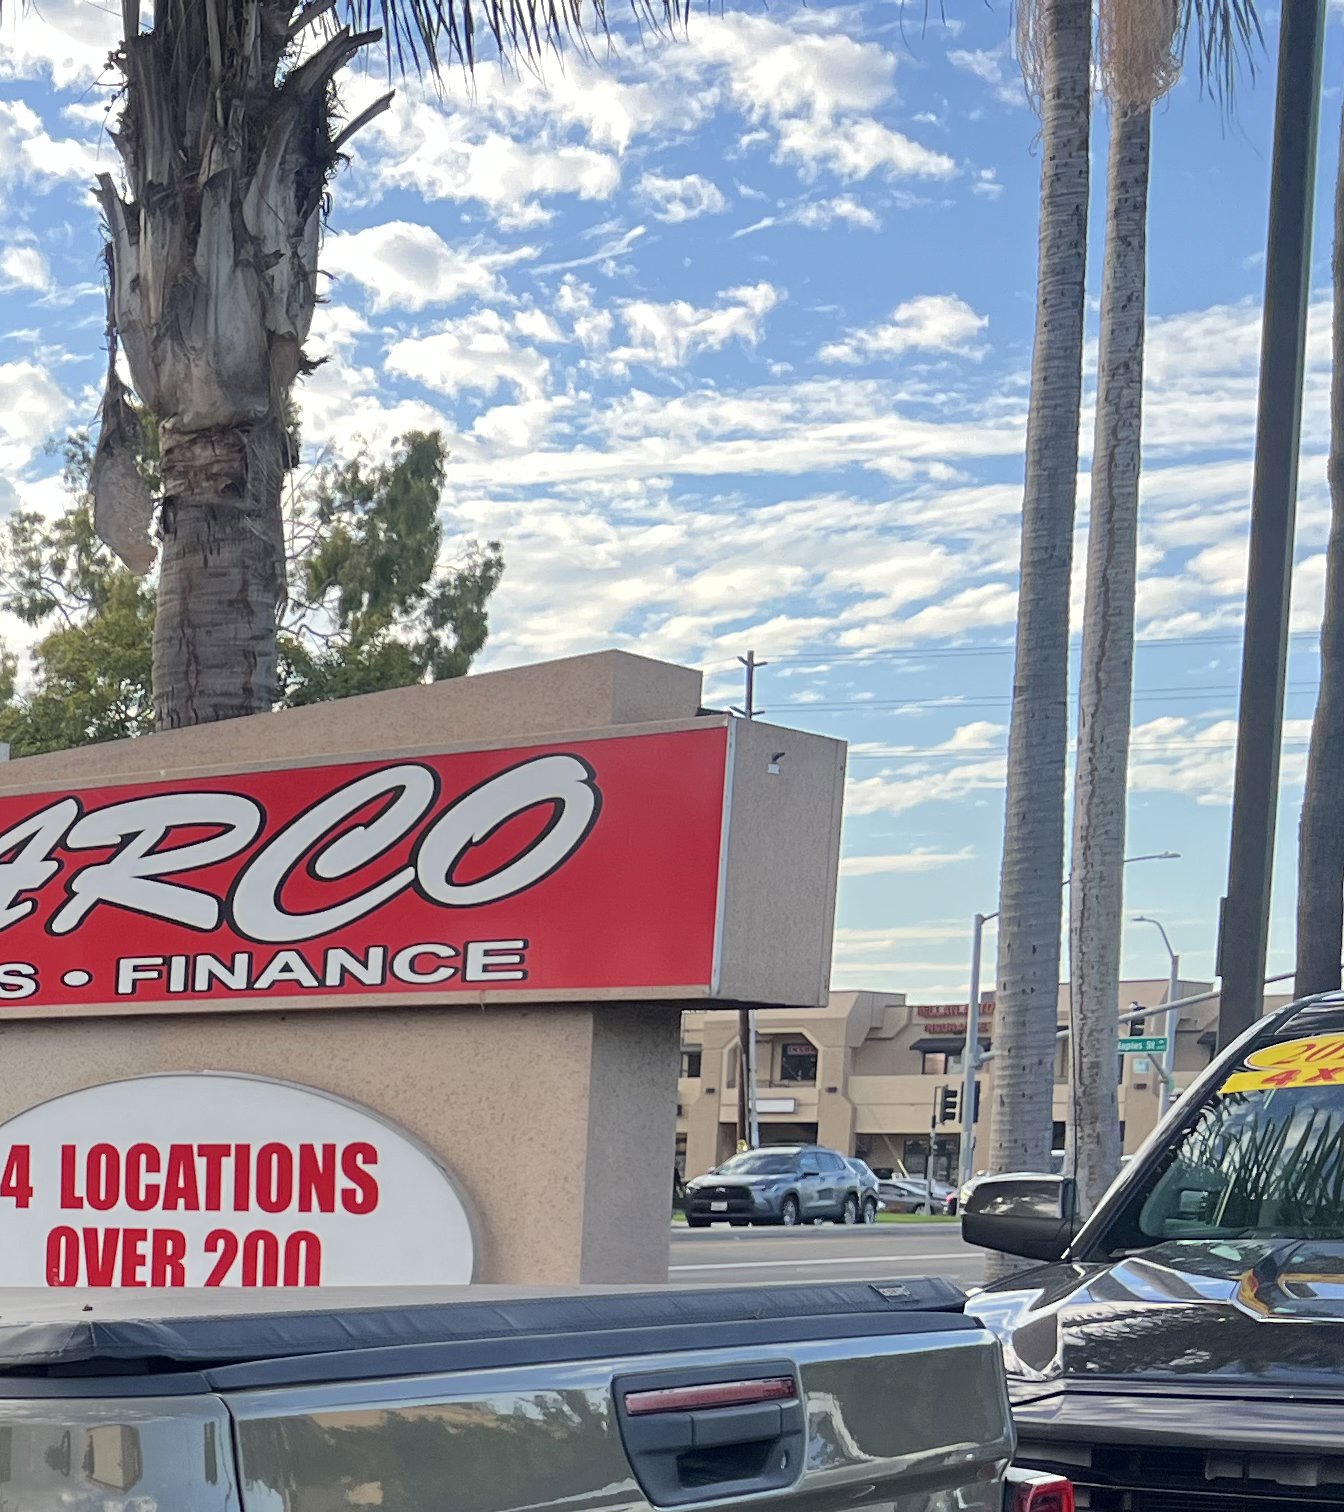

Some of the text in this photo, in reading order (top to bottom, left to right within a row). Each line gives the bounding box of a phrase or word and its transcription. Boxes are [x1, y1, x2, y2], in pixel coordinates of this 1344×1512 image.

[114, 938, 529, 995] FINANCE
[1268, 1039, 1344, 1066] 20
[0, 1142, 379, 1214] 4 LOCATIONS
[46, 1226, 322, 1287] OVER 200
